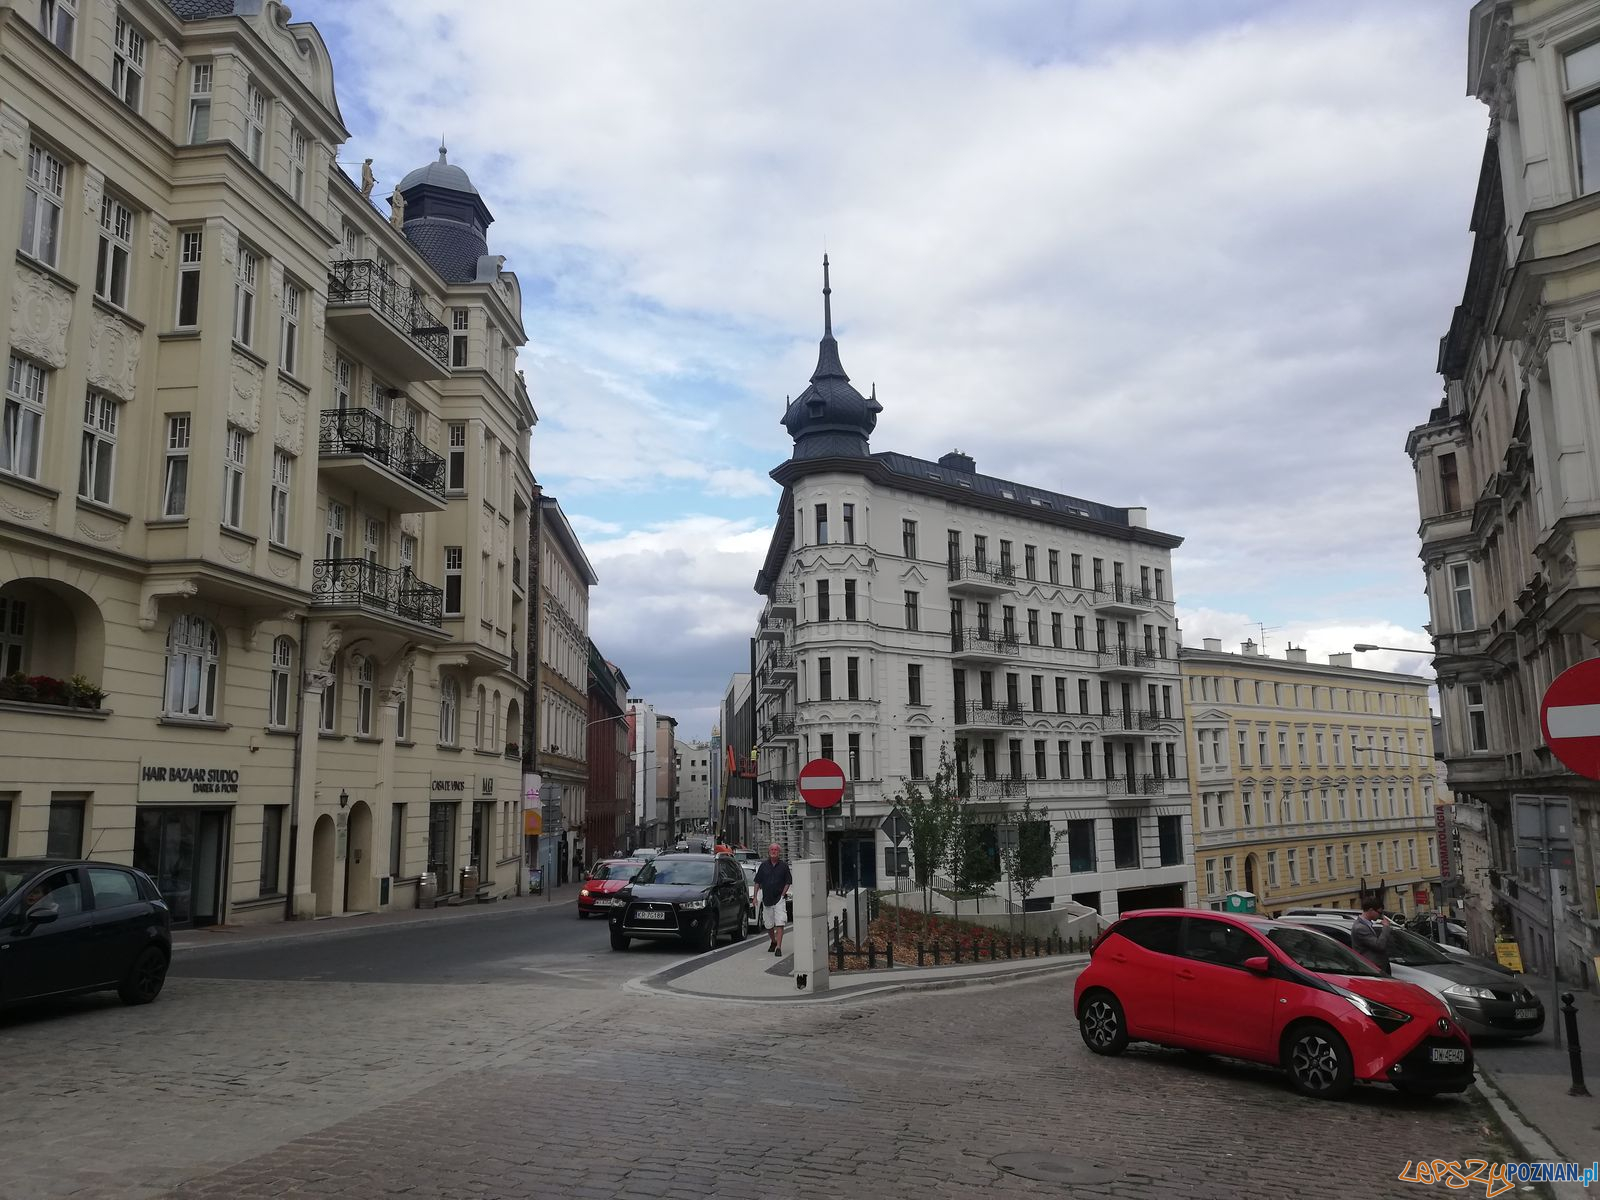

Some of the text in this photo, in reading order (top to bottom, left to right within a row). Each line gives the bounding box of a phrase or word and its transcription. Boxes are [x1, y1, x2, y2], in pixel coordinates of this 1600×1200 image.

[142, 766, 239, 783] HAIR BAZAAR STUDIO
[193, 783, 214, 793] DAREK
[214, 784, 220, 793] &
[431, 780, 445, 791] CASA
[1435, 805, 1451, 878] STOMATOLOGIA
